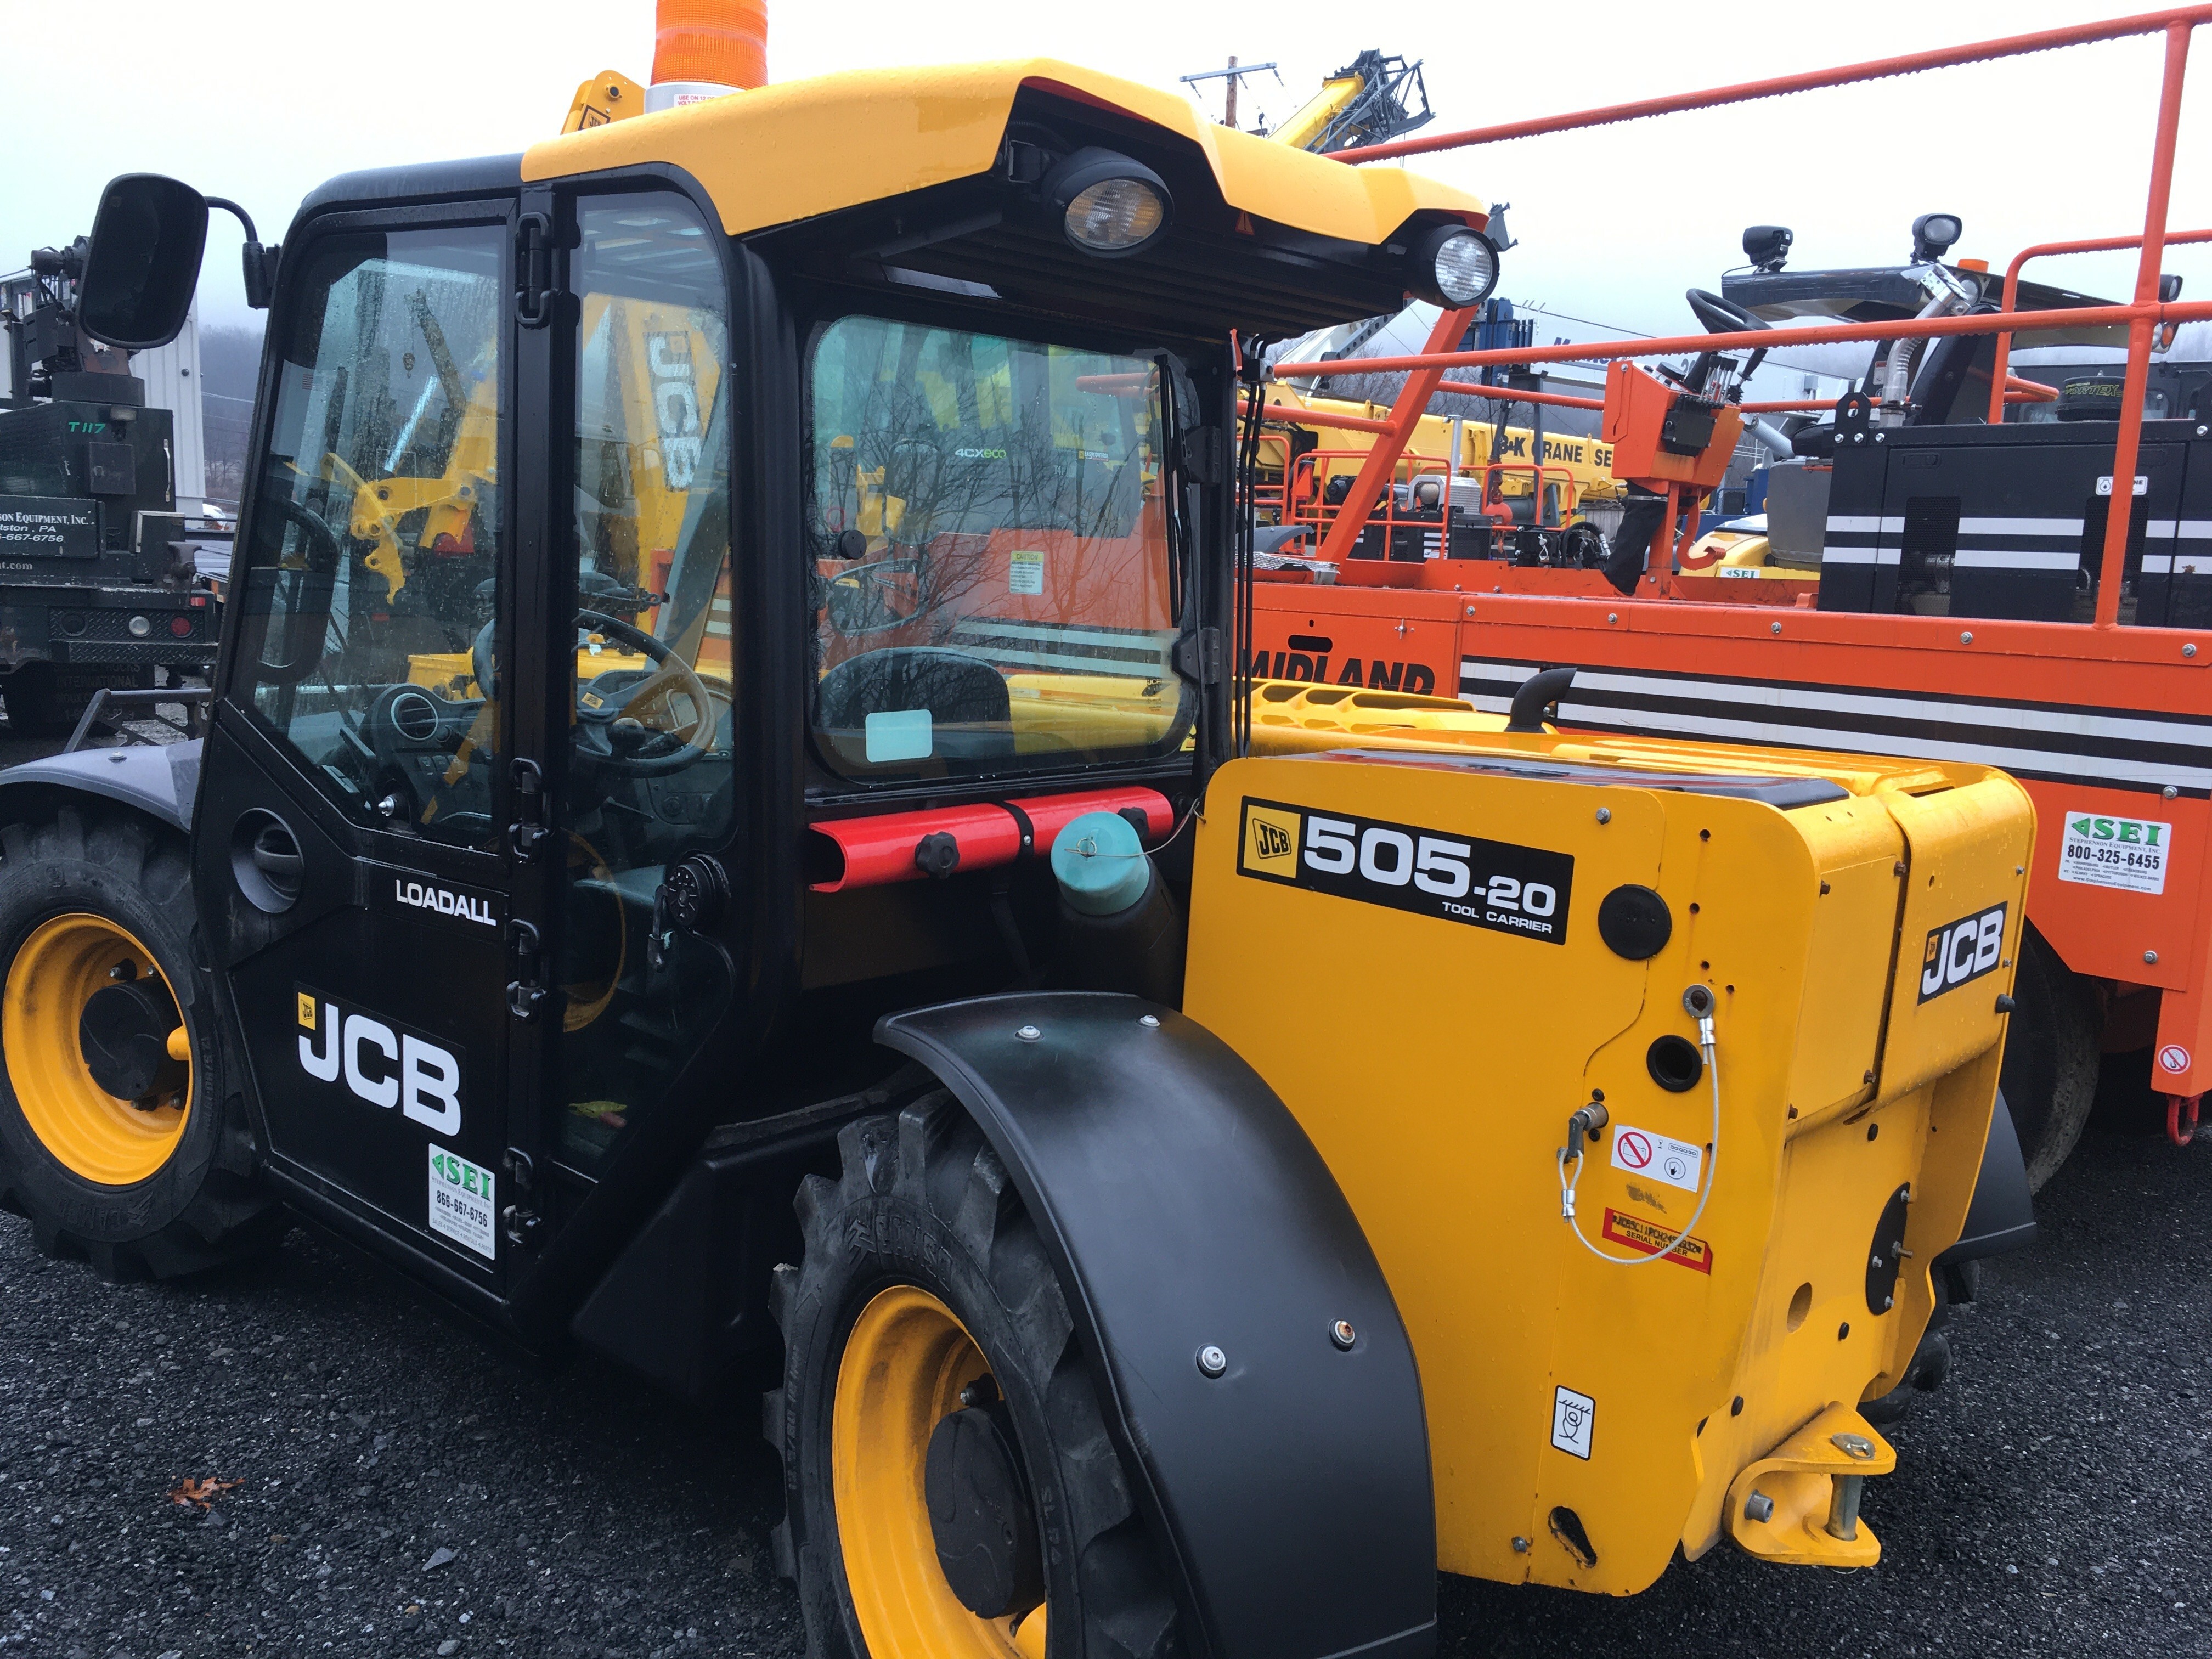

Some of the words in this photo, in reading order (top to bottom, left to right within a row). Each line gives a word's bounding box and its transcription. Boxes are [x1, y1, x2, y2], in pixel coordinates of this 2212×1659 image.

[1532, 441, 1583, 463] RANE
[71, 515, 89, 525] INC.
[0, 533, 64, 543] -667-6756
[0, 562, 33, 570] t.com
[1733, 569, 1755, 578] SEI
[1242, 648, 1435, 696] MIDLAND
[1259, 824, 1289, 854] JCB
[2069, 837, 2108, 847] STEPHENSON
[2092, 818, 2163, 847] SEI
[2068, 844, 2160, 870] 800-325-6455
[396, 879, 496, 926] LOADALL
[1442, 901, 1479, 918] TOOL
[1486, 911, 1552, 934] CARRIER
[1922, 910, 2004, 995] JCB
[298, 1003, 461, 1136] JCB
[447, 1156, 491, 1201] SEI
[437, 1190, 488, 1227] 866-667-6756
[1626, 1230, 1653, 1245] SERIAL
